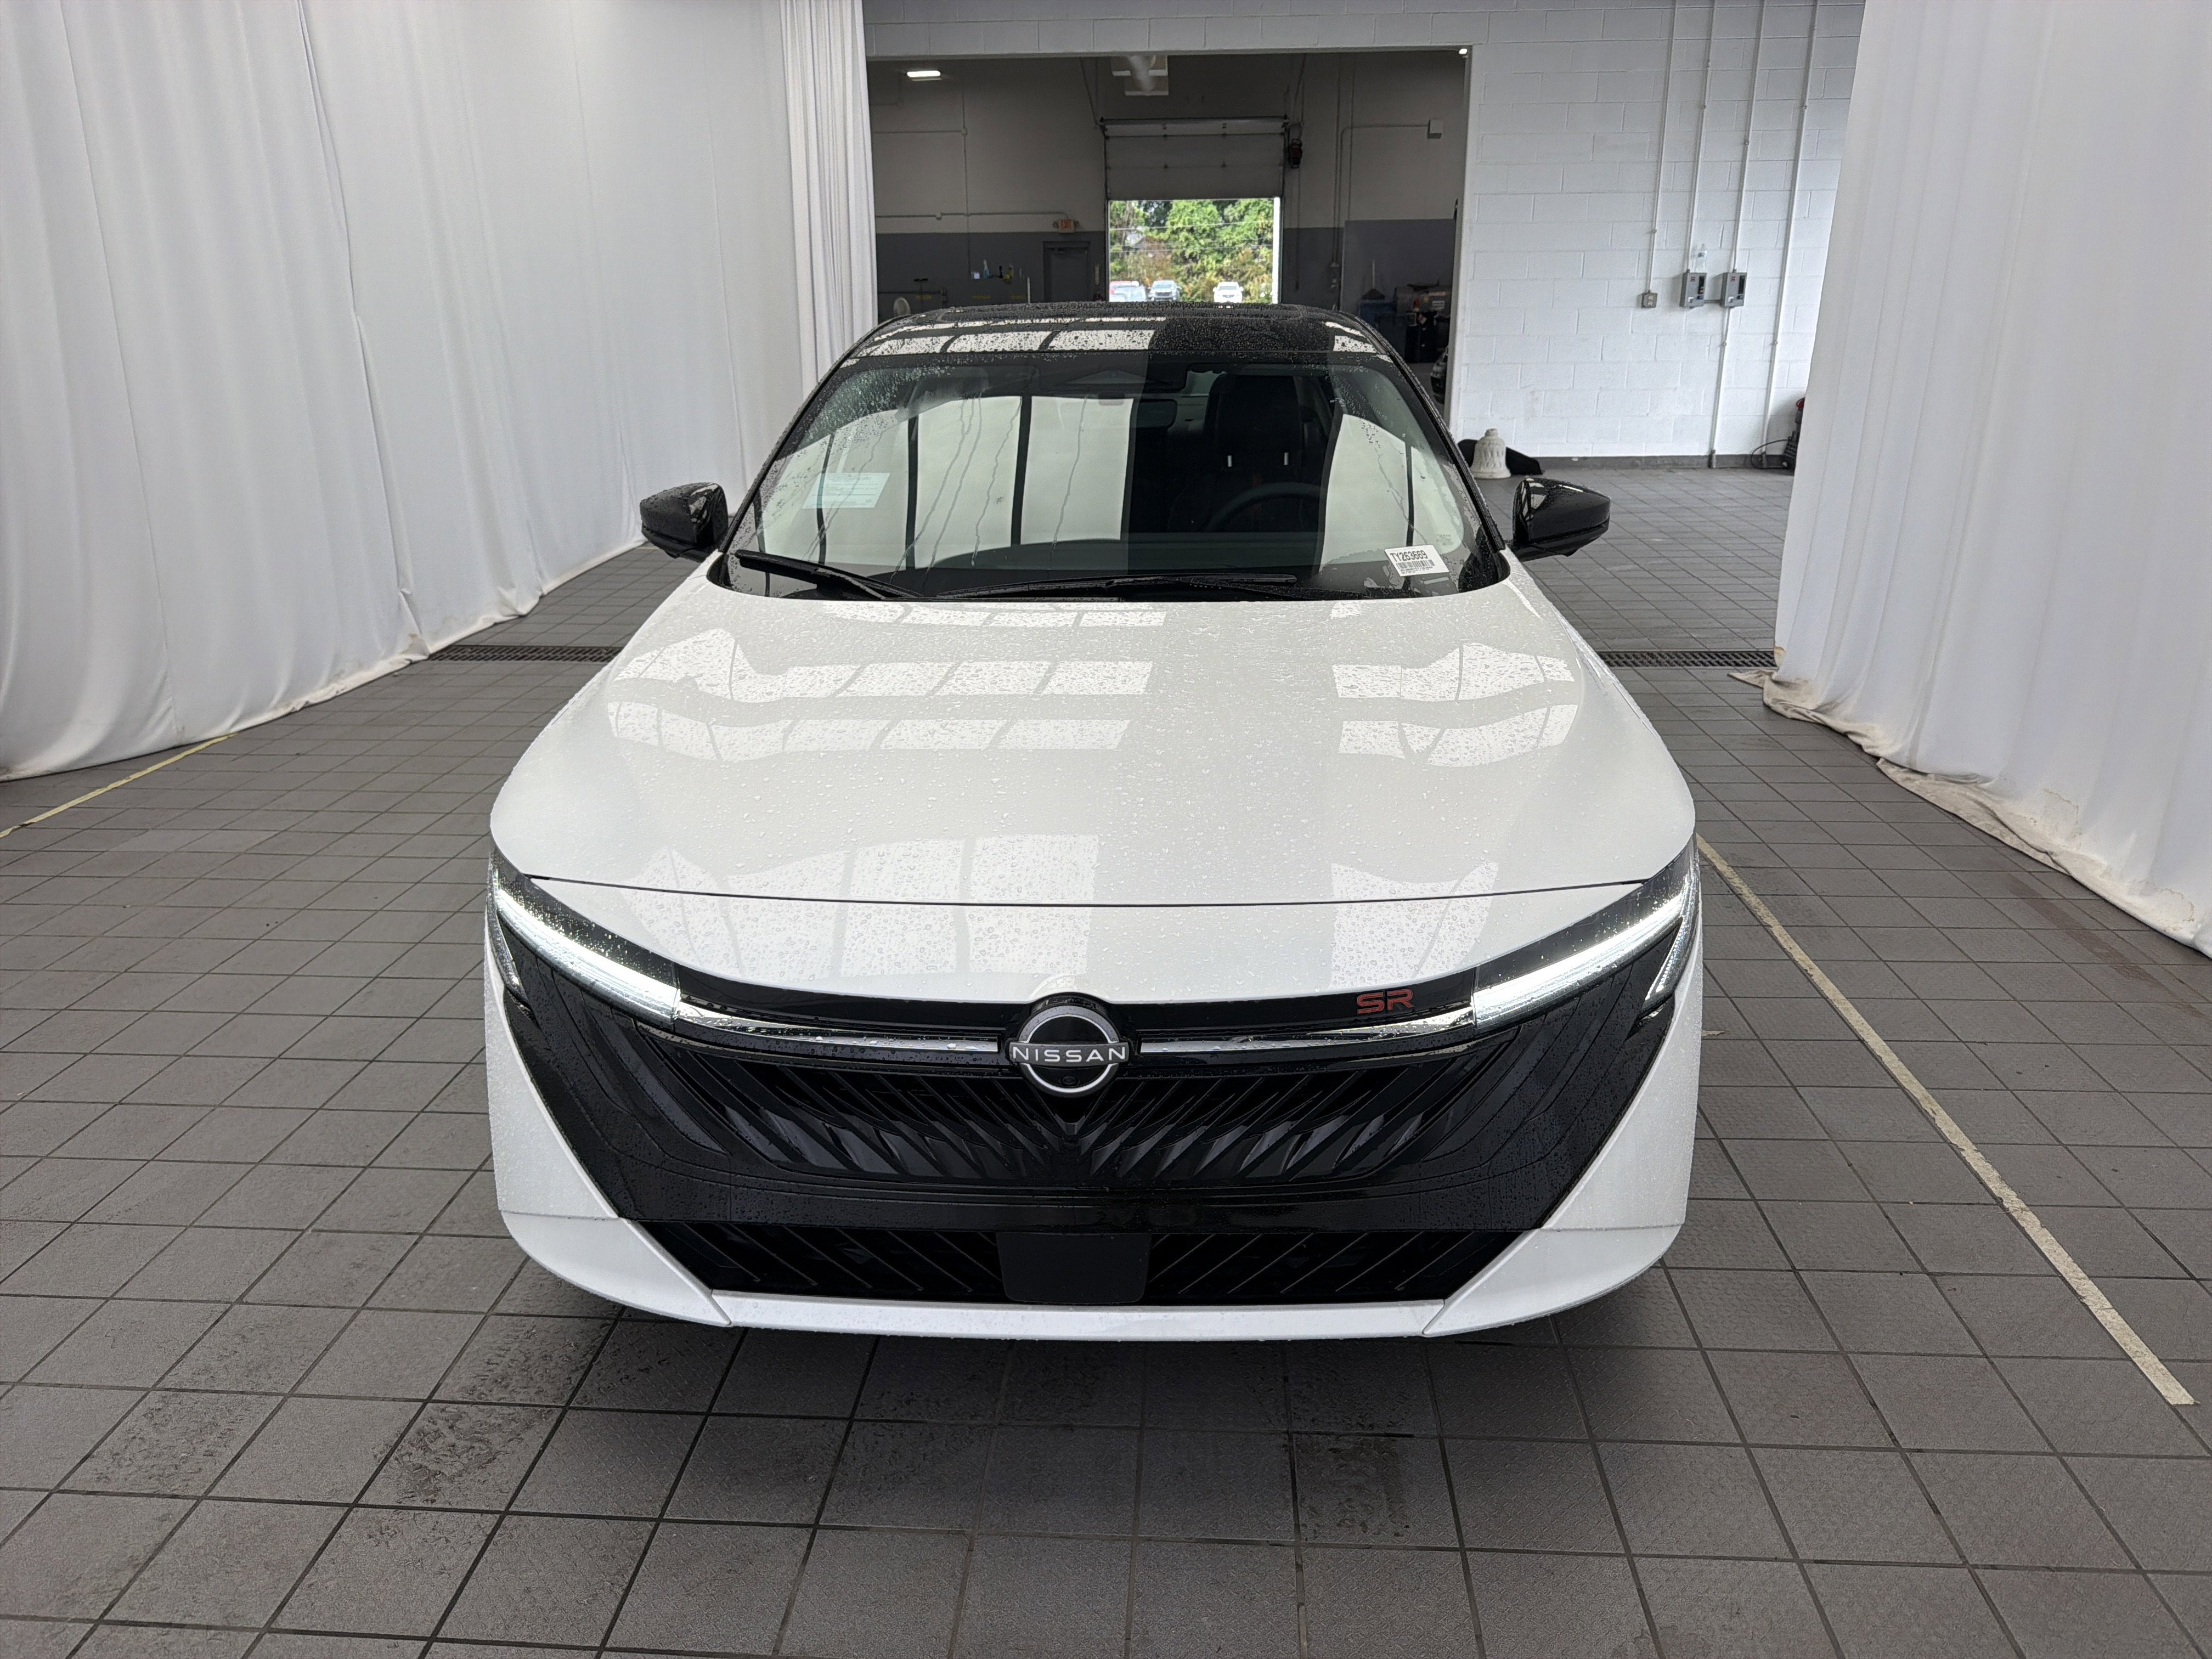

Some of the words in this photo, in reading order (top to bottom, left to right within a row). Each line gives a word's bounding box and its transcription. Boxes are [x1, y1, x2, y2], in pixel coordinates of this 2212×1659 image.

[1390, 550, 1428, 562] TY263669
[1356, 988, 1414, 1014] SR
[1013, 1046, 1125, 1062] NISSAN
